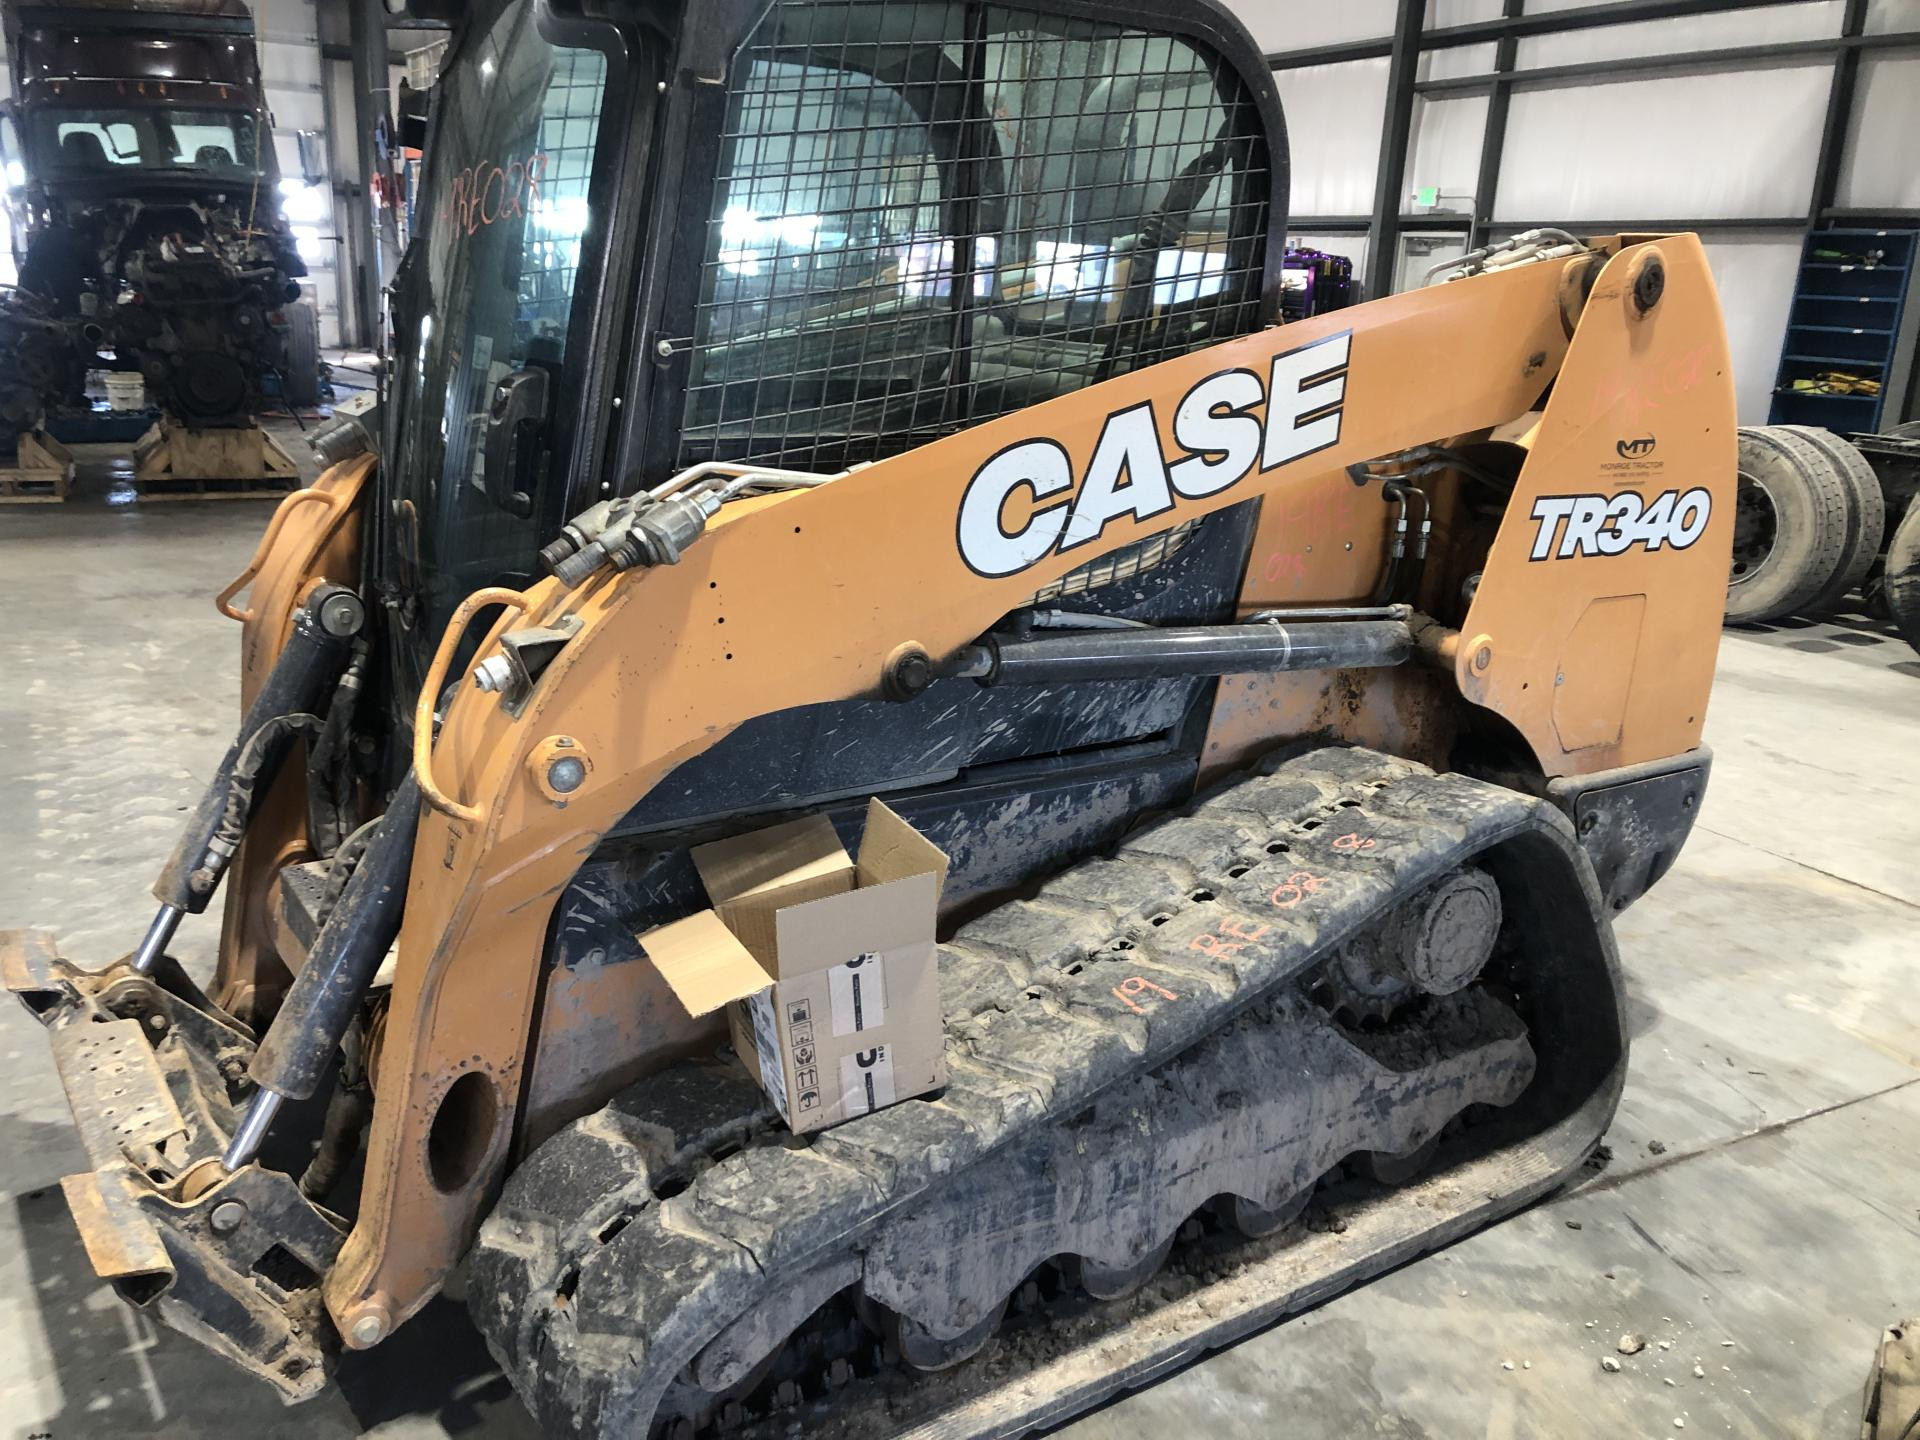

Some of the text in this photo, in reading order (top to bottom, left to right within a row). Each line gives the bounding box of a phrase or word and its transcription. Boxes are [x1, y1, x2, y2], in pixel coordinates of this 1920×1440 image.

[956, 328, 1352, 579] CASE
[1528, 486, 1713, 562] TR340
[1112, 976, 1178, 1014] 19
[1189, 915, 1272, 960] RE
